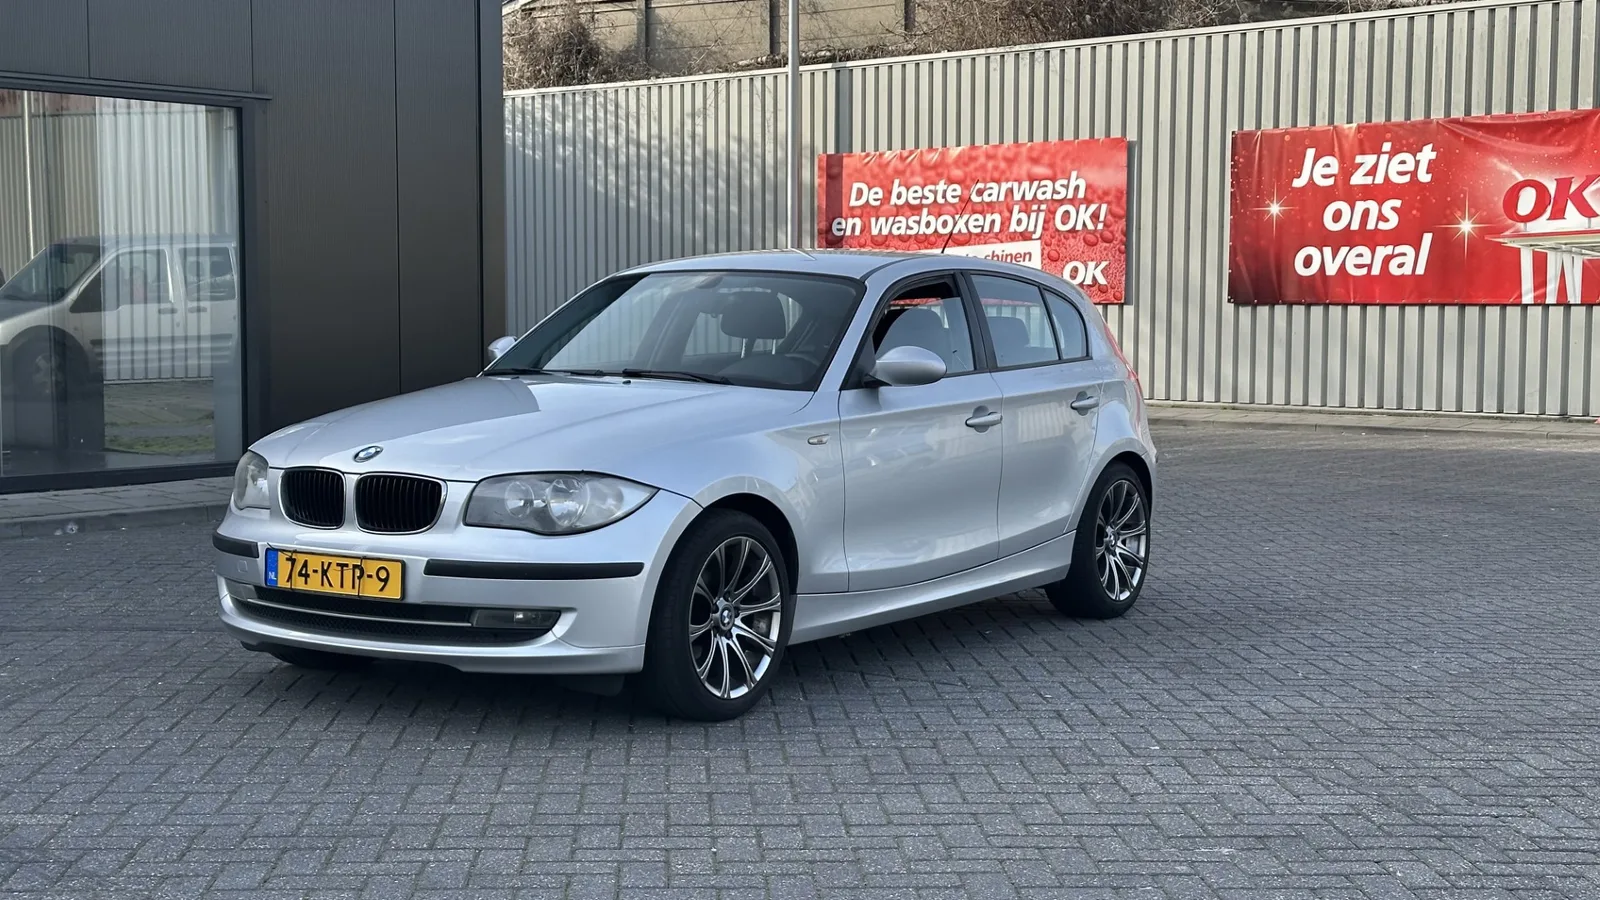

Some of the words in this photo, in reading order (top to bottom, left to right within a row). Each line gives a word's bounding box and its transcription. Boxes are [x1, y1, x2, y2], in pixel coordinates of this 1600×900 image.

[1291, 147, 1339, 188] Je
[1349, 141, 1437, 185] ziet
[848, 182, 884, 207] De
[889, 178, 962, 206] beste
[969, 170, 1087, 203] carwash
[1502, 174, 1600, 223] OK
[831, 217, 862, 237] en
[870, 207, 1002, 237] wasboxen
[1008, 204, 1046, 240] bij
[1053, 203, 1108, 232] OK!
[1322, 199, 1403, 232] ons
[1062, 260, 1110, 286] OK
[1293, 232, 1433, 277] overal
[268, 571, 277, 580] NL
[285, 556, 391, 592] 74-KTP-9
